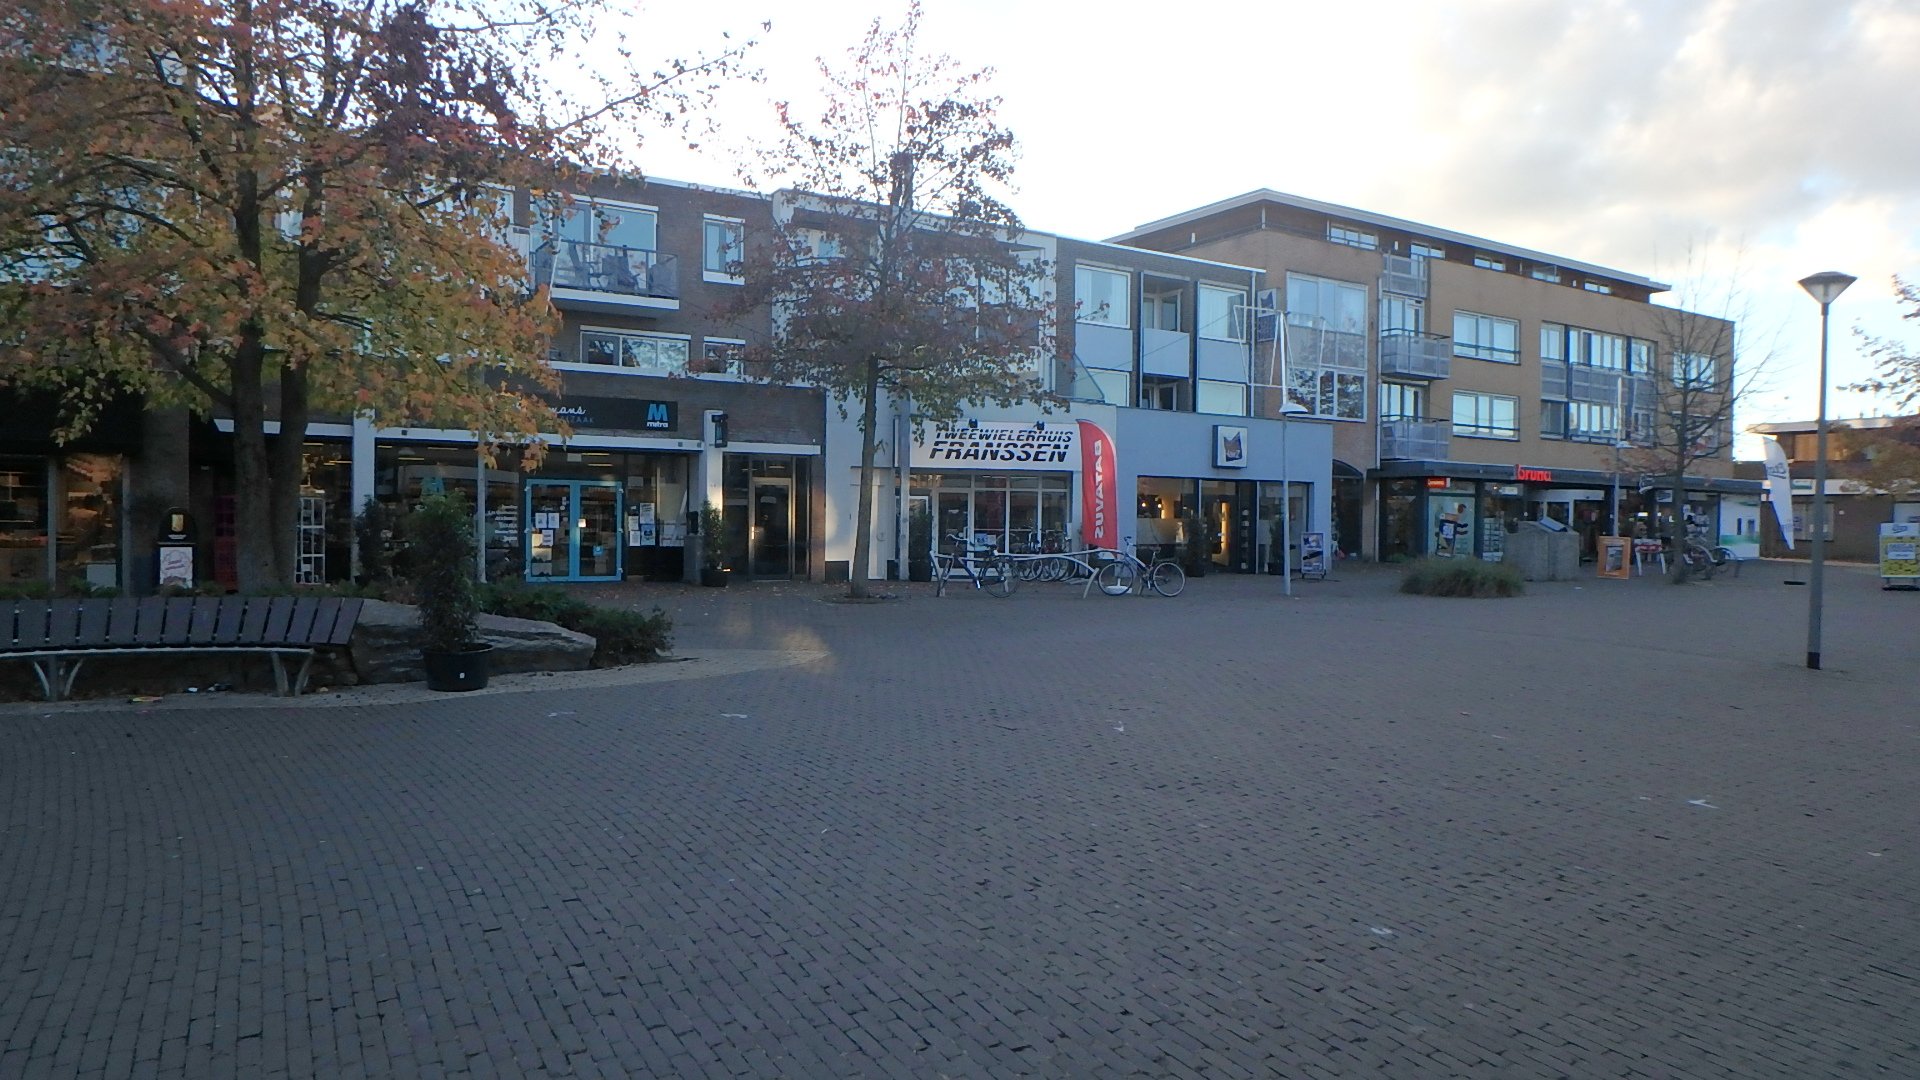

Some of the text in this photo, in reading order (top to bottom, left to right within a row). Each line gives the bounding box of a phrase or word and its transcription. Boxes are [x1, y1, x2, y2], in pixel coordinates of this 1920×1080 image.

[646, 421, 669, 429] mitra
[936, 427, 1074, 443] TWEEWIELERHUIS
[929, 440, 1070, 462] FRANSSEN
[1516, 463, 1552, 482] bruna
